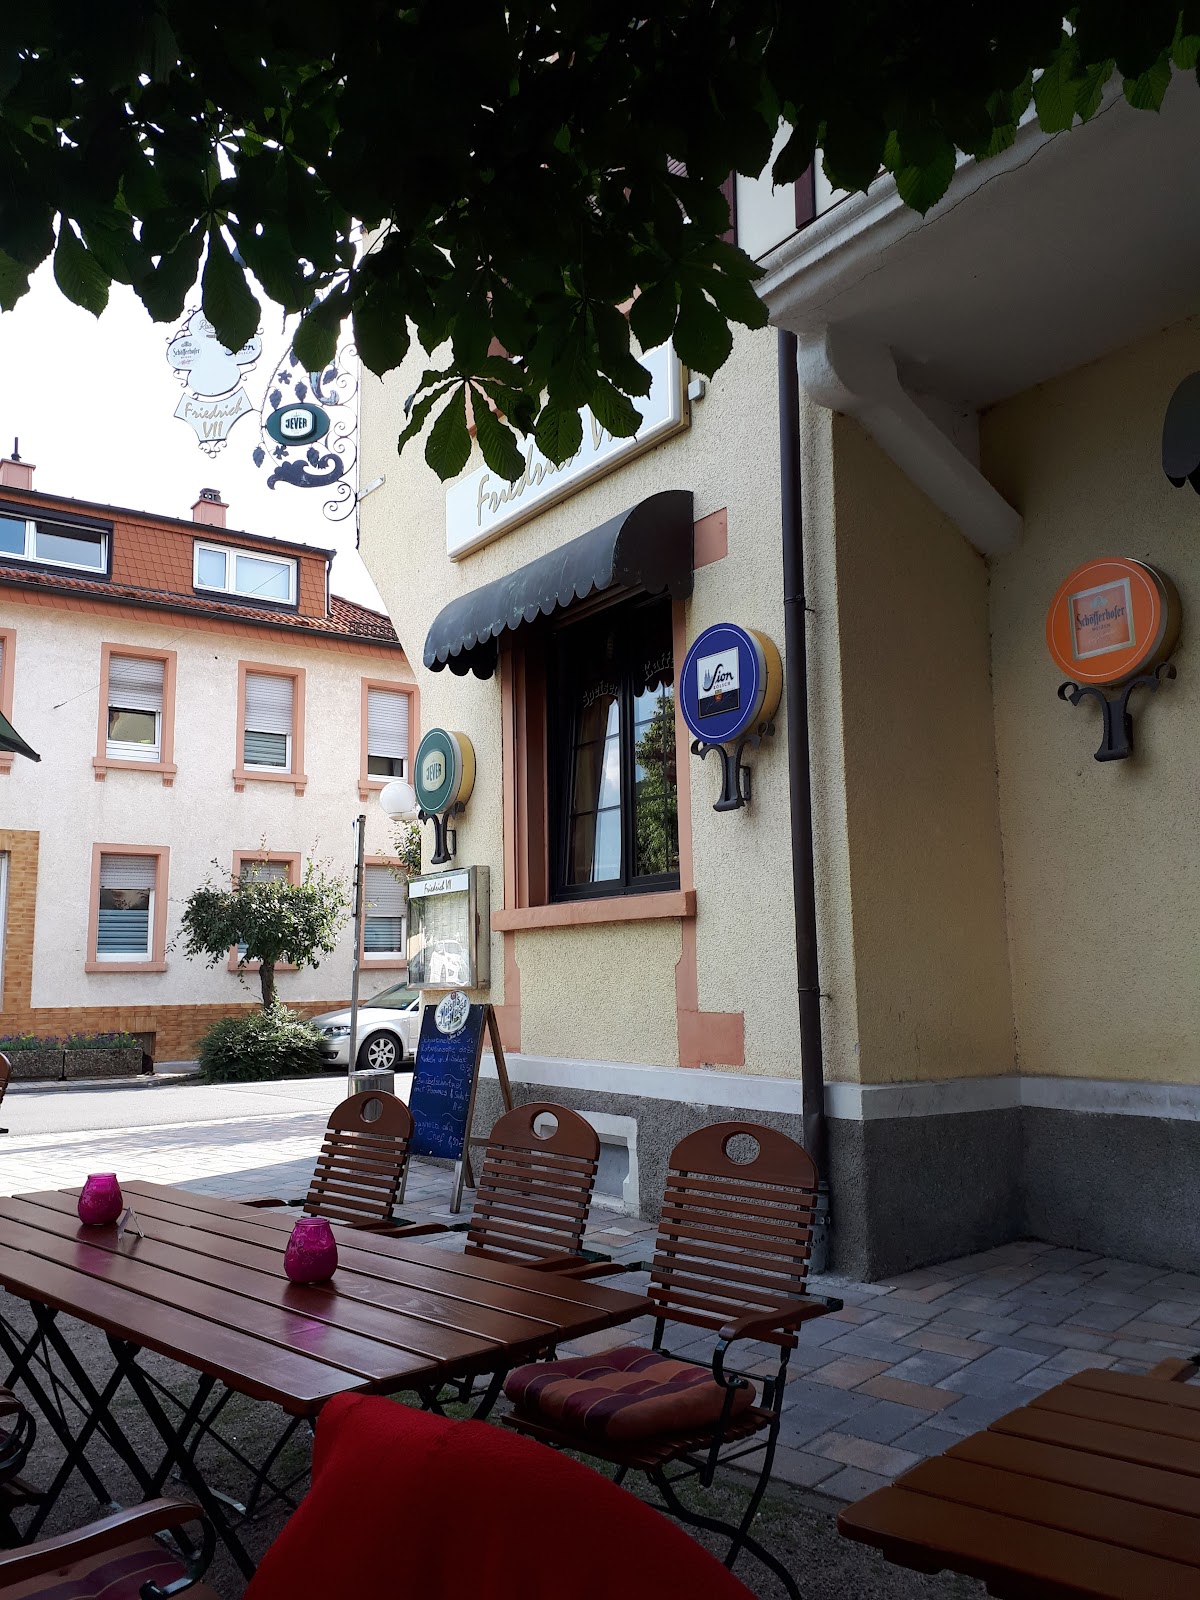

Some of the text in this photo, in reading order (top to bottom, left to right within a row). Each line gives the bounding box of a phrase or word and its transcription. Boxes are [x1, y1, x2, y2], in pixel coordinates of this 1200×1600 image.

[184, 397, 243, 419] Friedrich
[203, 421, 223, 438] VII
[285, 417, 307, 430] JEVER
[1076, 604, 1125, 631] Schöfferhofer
[703, 663, 734, 692] Sion
[426, 762, 442, 781] JEVER
[424, 880, 445, 894] Friedrich
